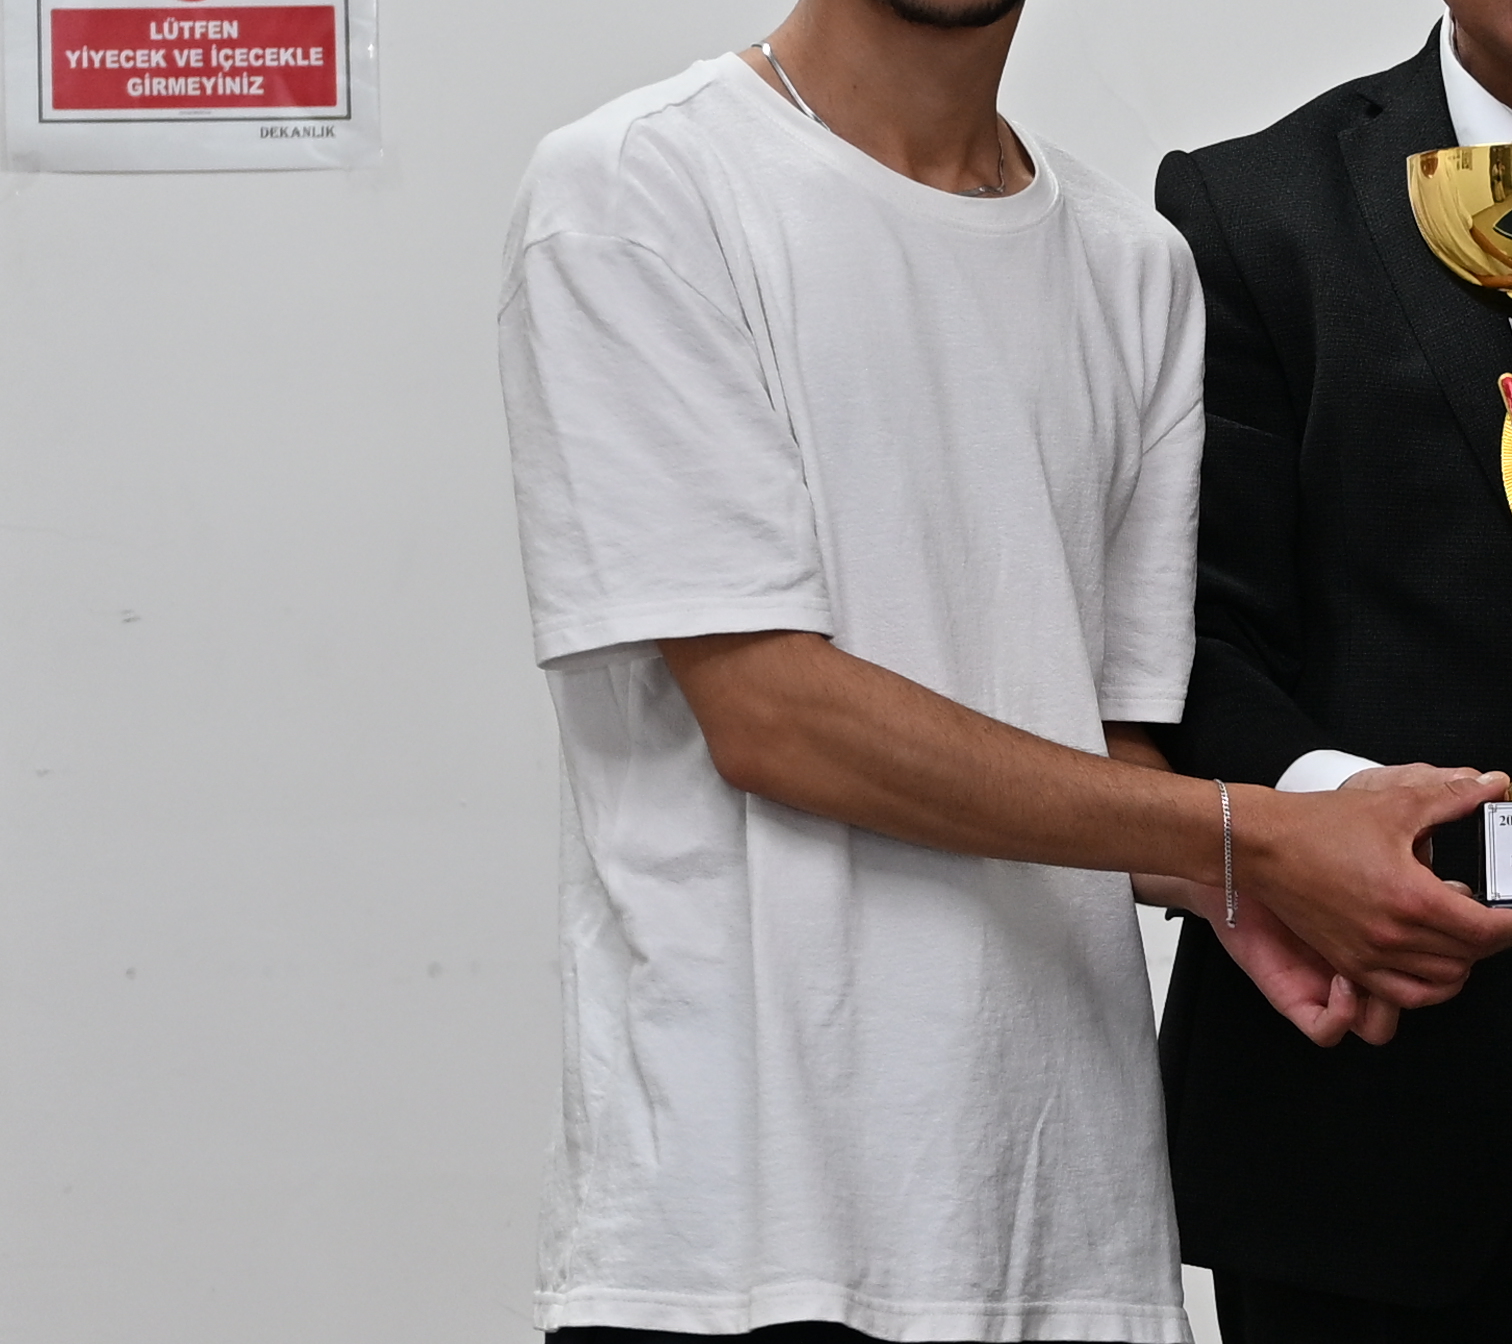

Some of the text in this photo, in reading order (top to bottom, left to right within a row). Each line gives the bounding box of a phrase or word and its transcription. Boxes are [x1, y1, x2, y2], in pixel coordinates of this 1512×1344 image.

[149, 17, 238, 41] LÜTFEN
[65, 44, 324, 72] YİYECEK VE İÇECEKLE
[127, 72, 264, 97] GİRMEYİNİZ
[259, 126, 336, 140] DEKANLIK
